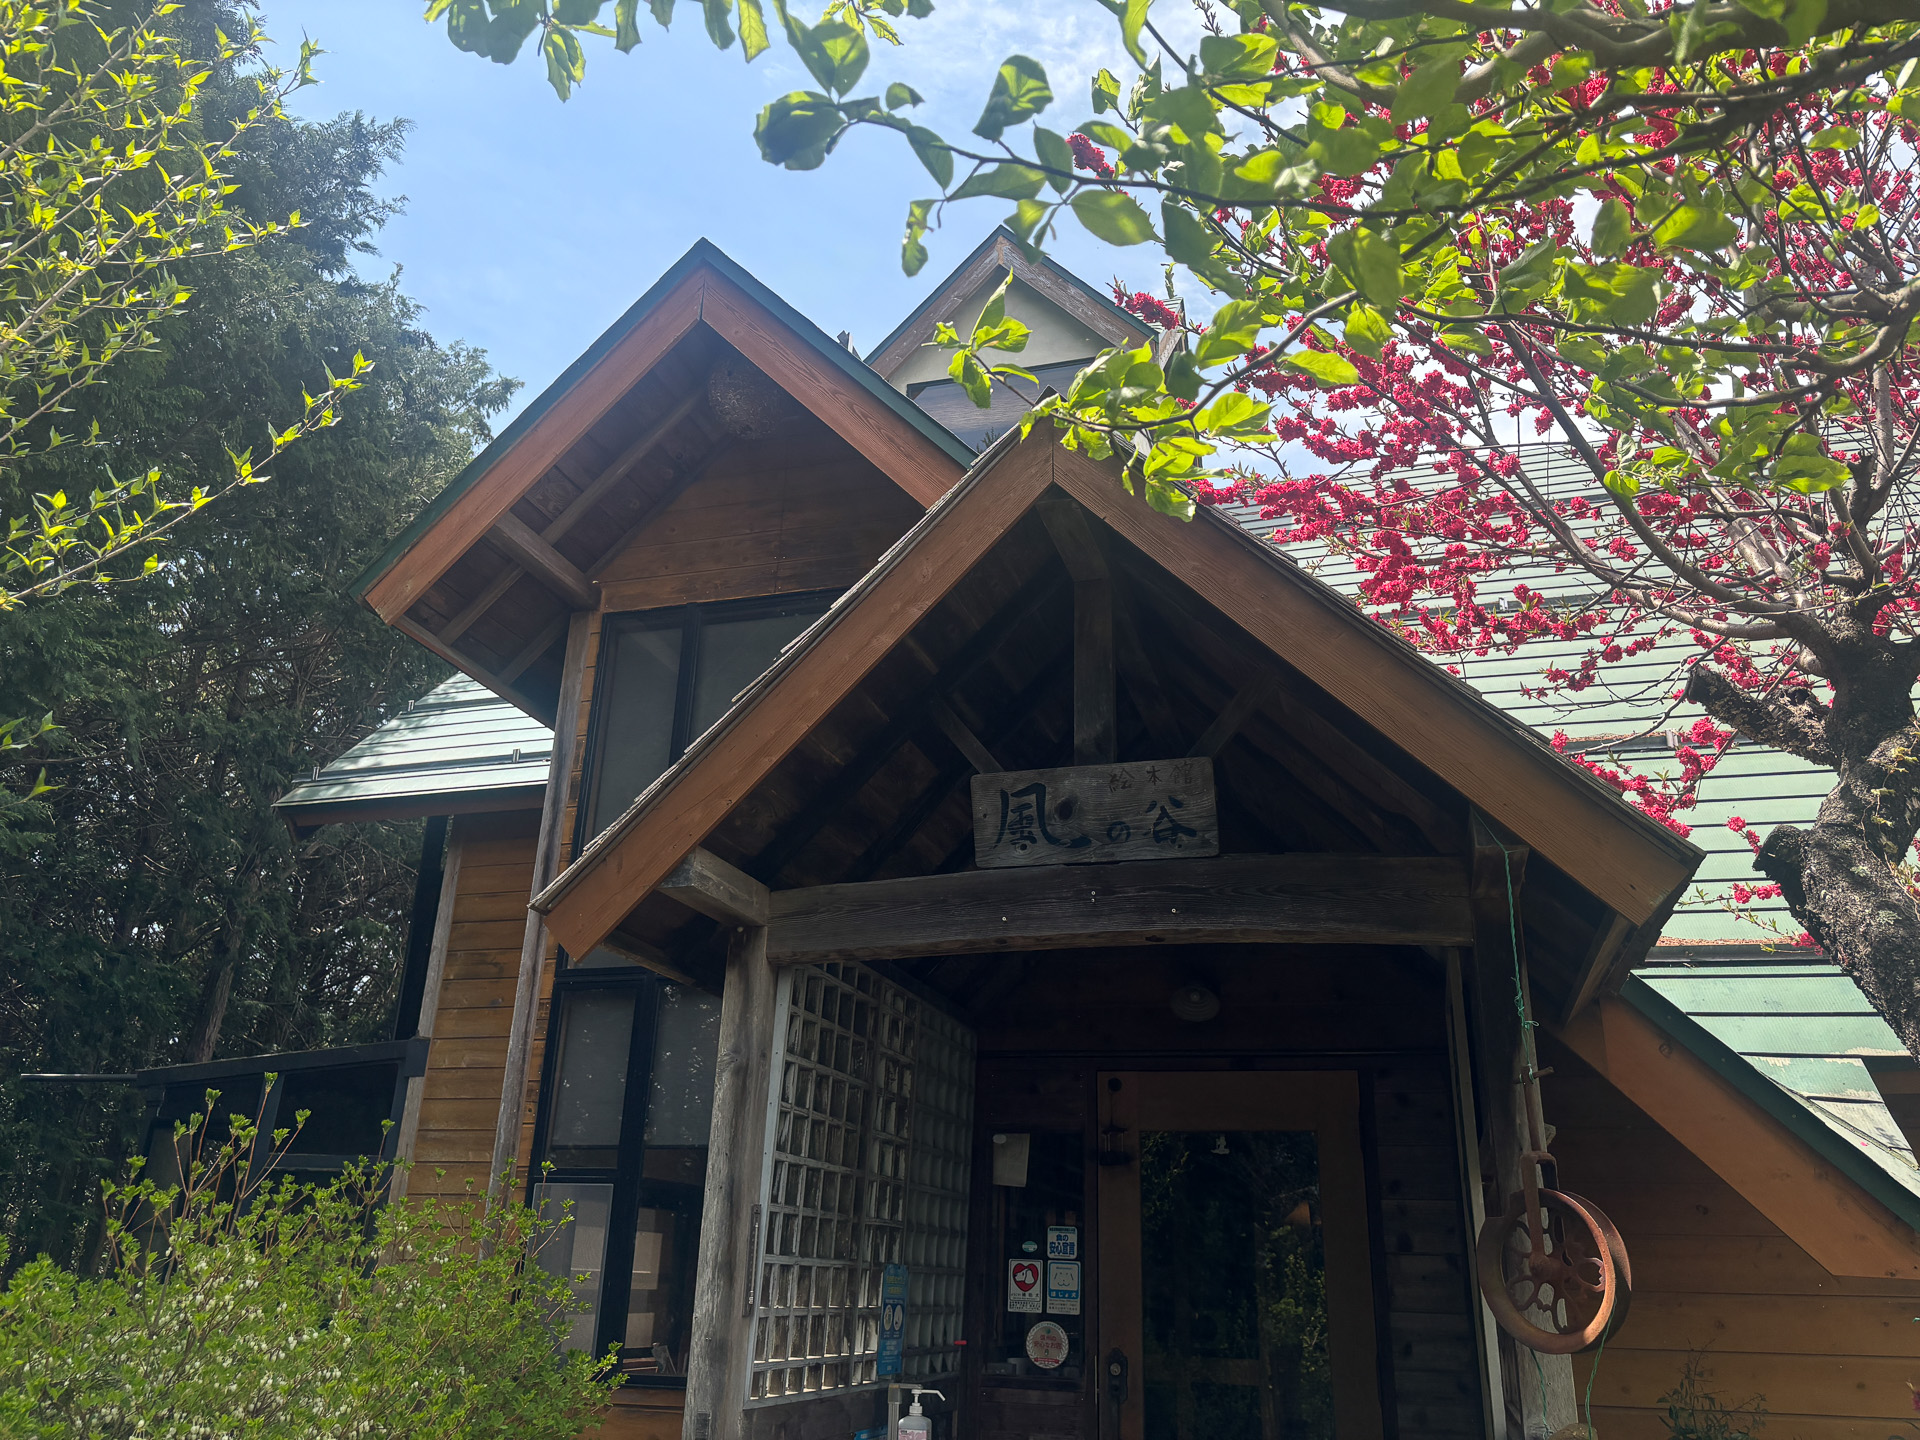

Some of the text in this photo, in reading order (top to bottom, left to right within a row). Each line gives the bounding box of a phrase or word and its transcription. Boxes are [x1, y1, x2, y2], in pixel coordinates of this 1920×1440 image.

[1108, 761, 1194, 793] 絵本館
[992, 782, 1197, 849] 風の谷
[1049, 1241, 1075, 1255] 安心宣言
